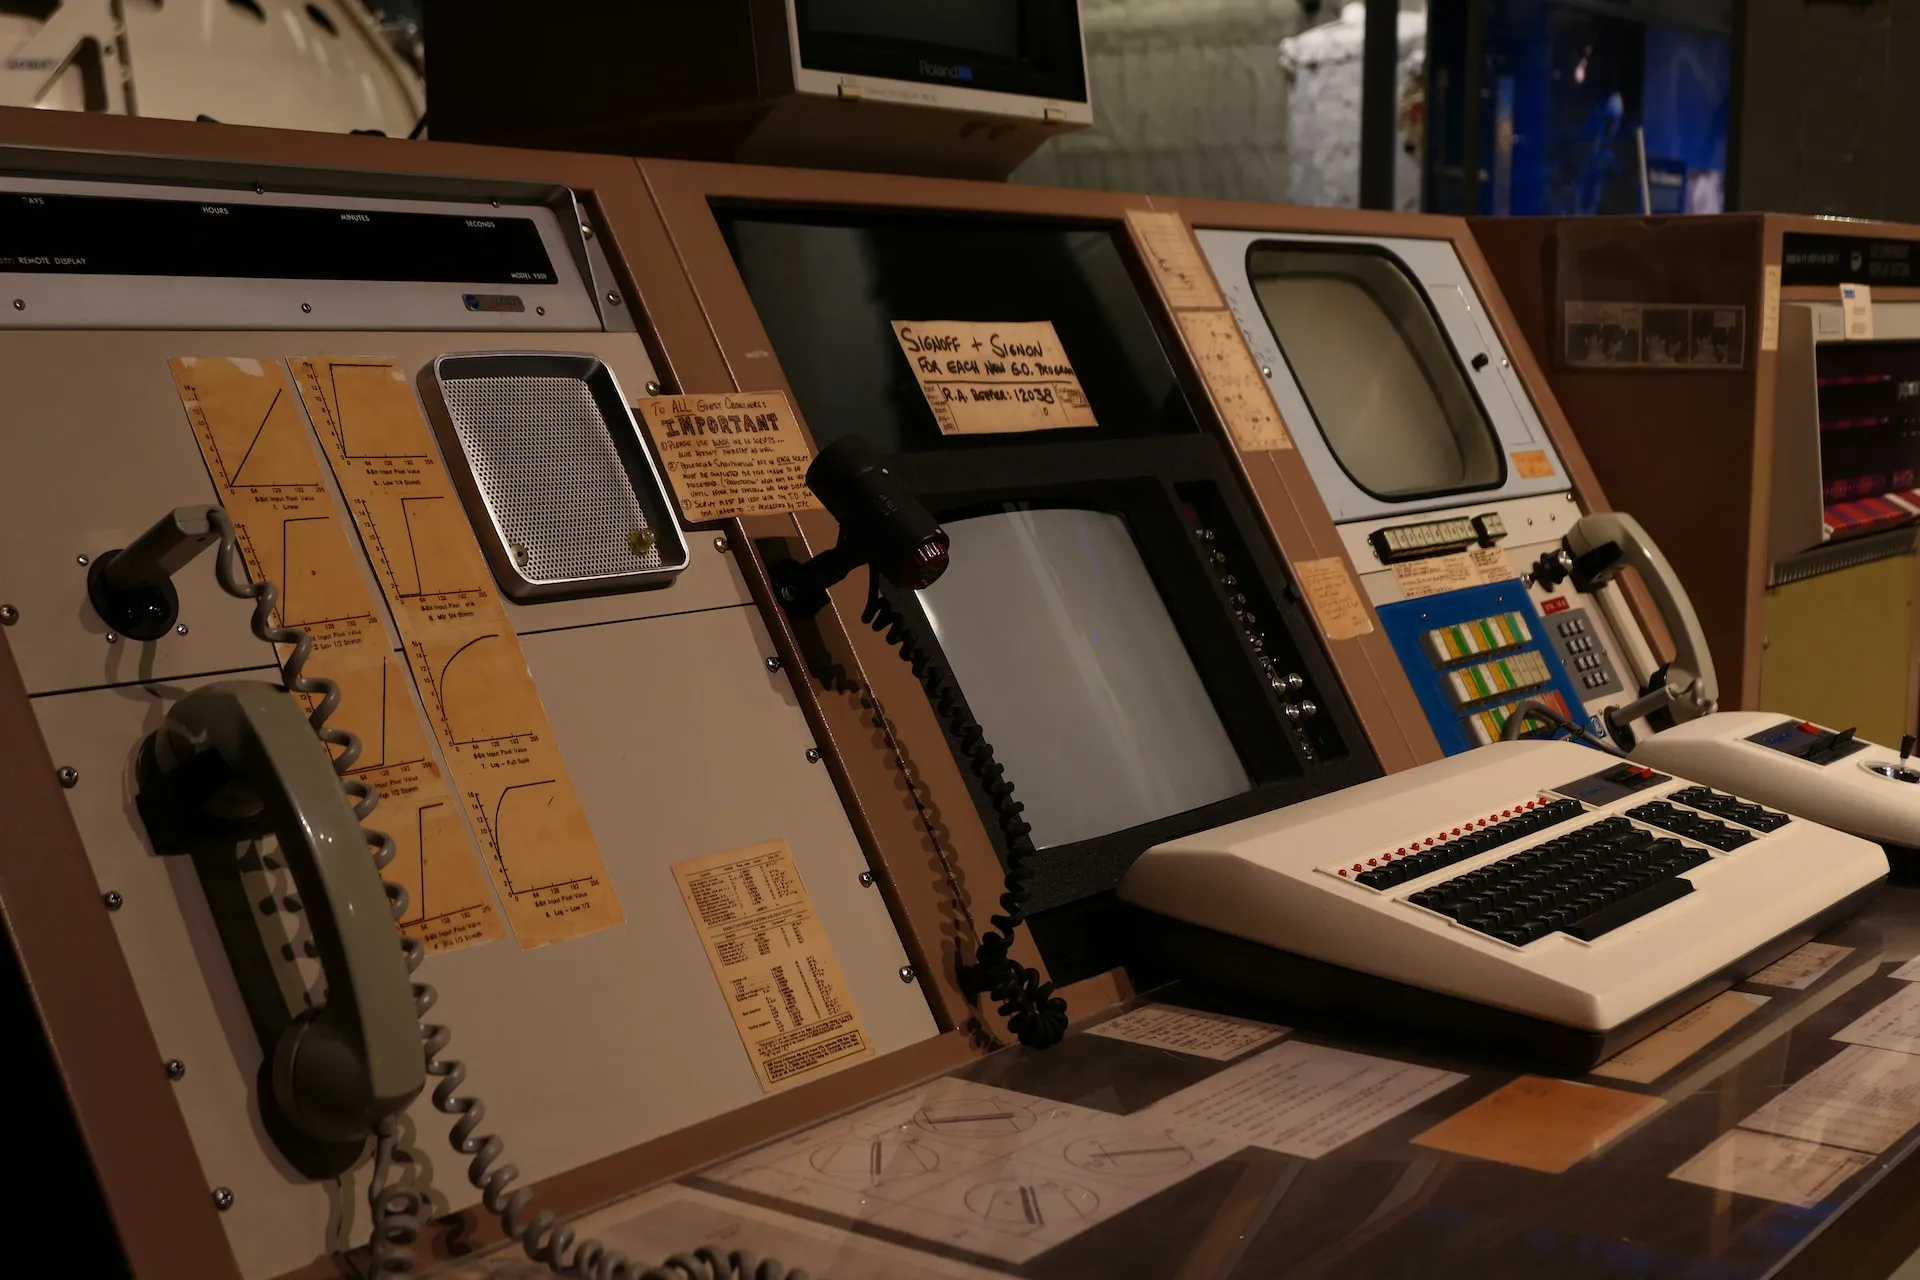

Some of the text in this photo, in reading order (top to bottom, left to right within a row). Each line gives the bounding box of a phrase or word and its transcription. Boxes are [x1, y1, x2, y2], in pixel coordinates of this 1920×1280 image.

[919, 60, 957, 78] Roland
[202, 206, 229, 215] HOURS
[341, 214, 370, 222] MINUTES
[466, 220, 495, 228] SECONDS
[54, 257, 87, 265] DISPLAY
[901, 327, 961, 352] SIGNOFF
[990, 334, 1043, 358] SIGNON
[917, 356, 943, 375] FOR
[947, 360, 980, 375] EACH
[942, 387, 968, 403] R.A.
[1014, 388, 1054, 404] 12038
[672, 399, 692, 413] ALL
[661, 412, 779, 437] IMPORTANT
[487, 750, 499, 758] Input
[490, 761, 500, 769] Log
[404, 775, 419, 783] Value
[554, 909, 563, 917] Log
